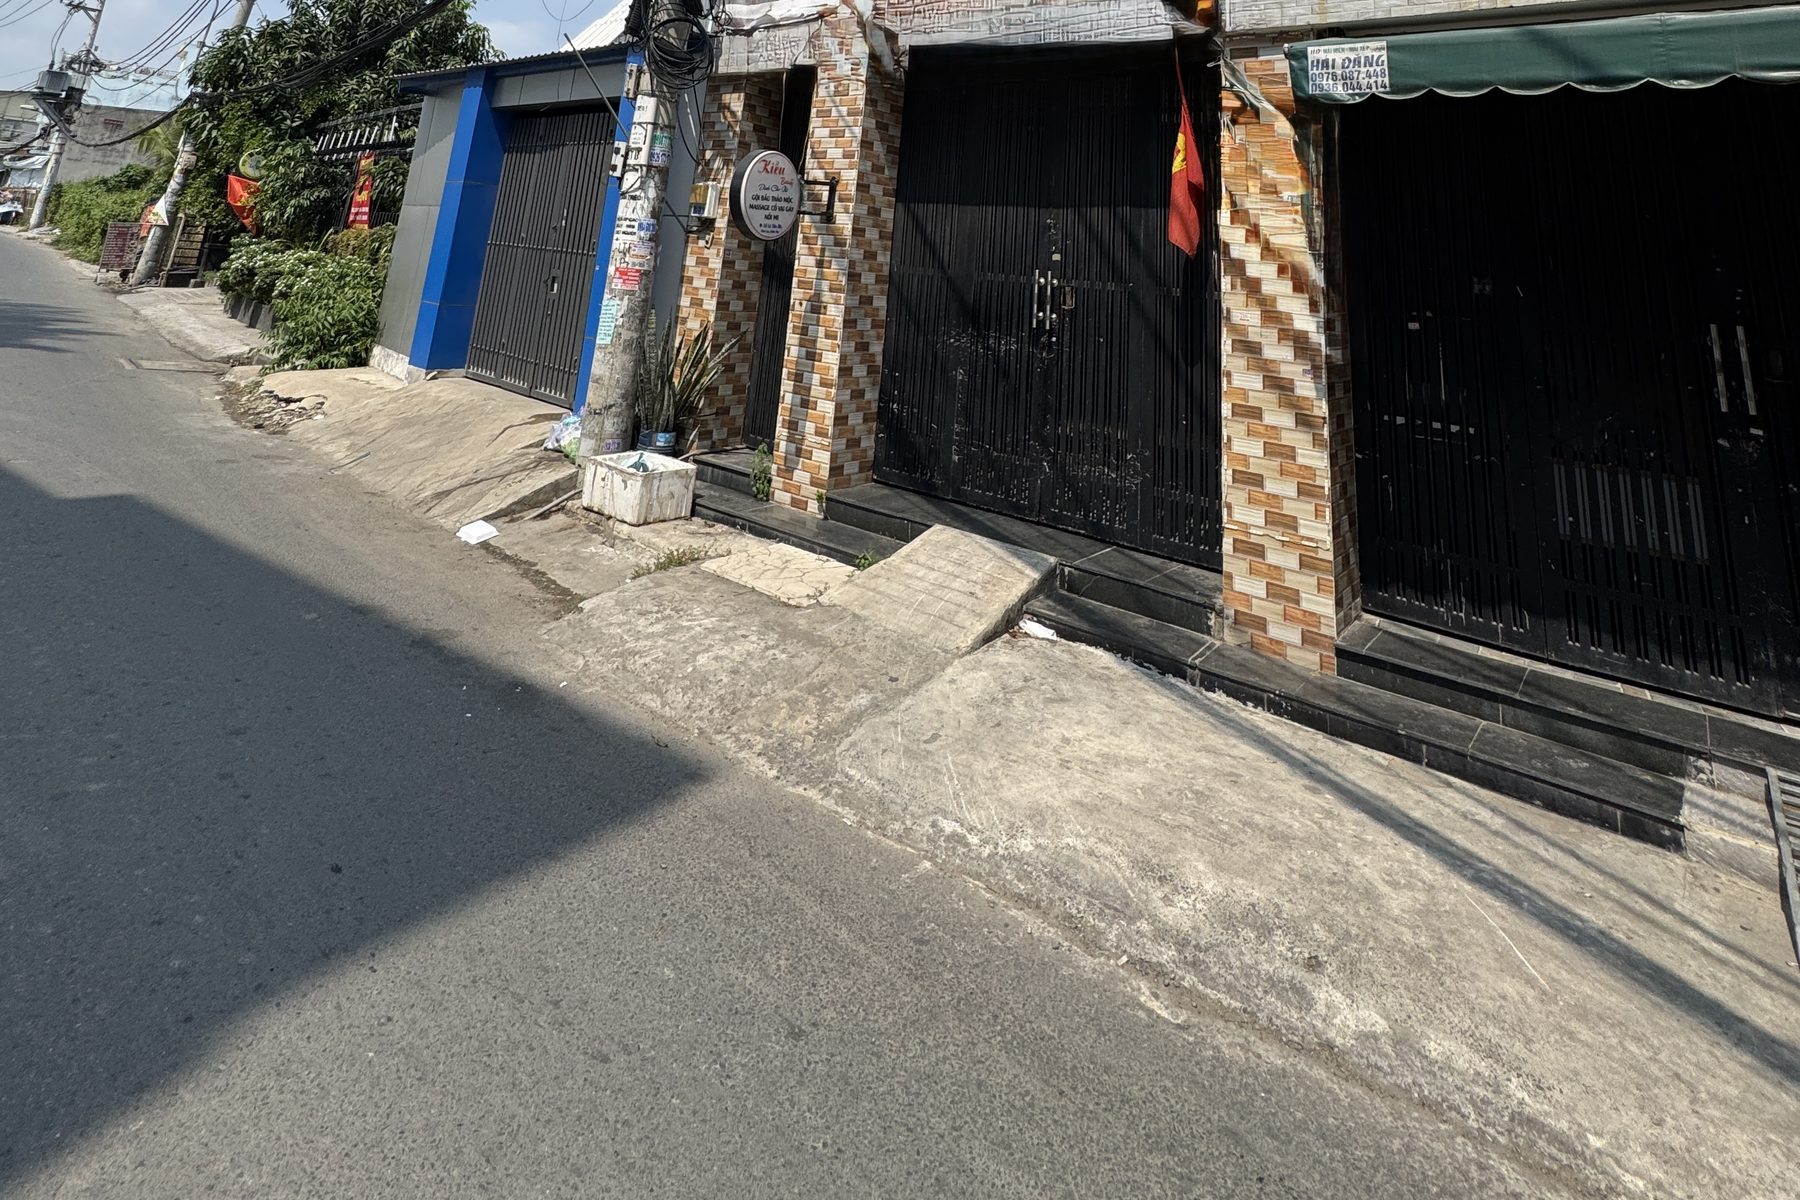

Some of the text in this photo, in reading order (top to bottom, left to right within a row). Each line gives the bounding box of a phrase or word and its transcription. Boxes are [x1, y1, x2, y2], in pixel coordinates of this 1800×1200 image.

[1310, 68, 1387, 82] 0976.087.448
[1311, 80, 1388, 93] 0936.044.414
[749, 203, 770, 211] MASSAGE
